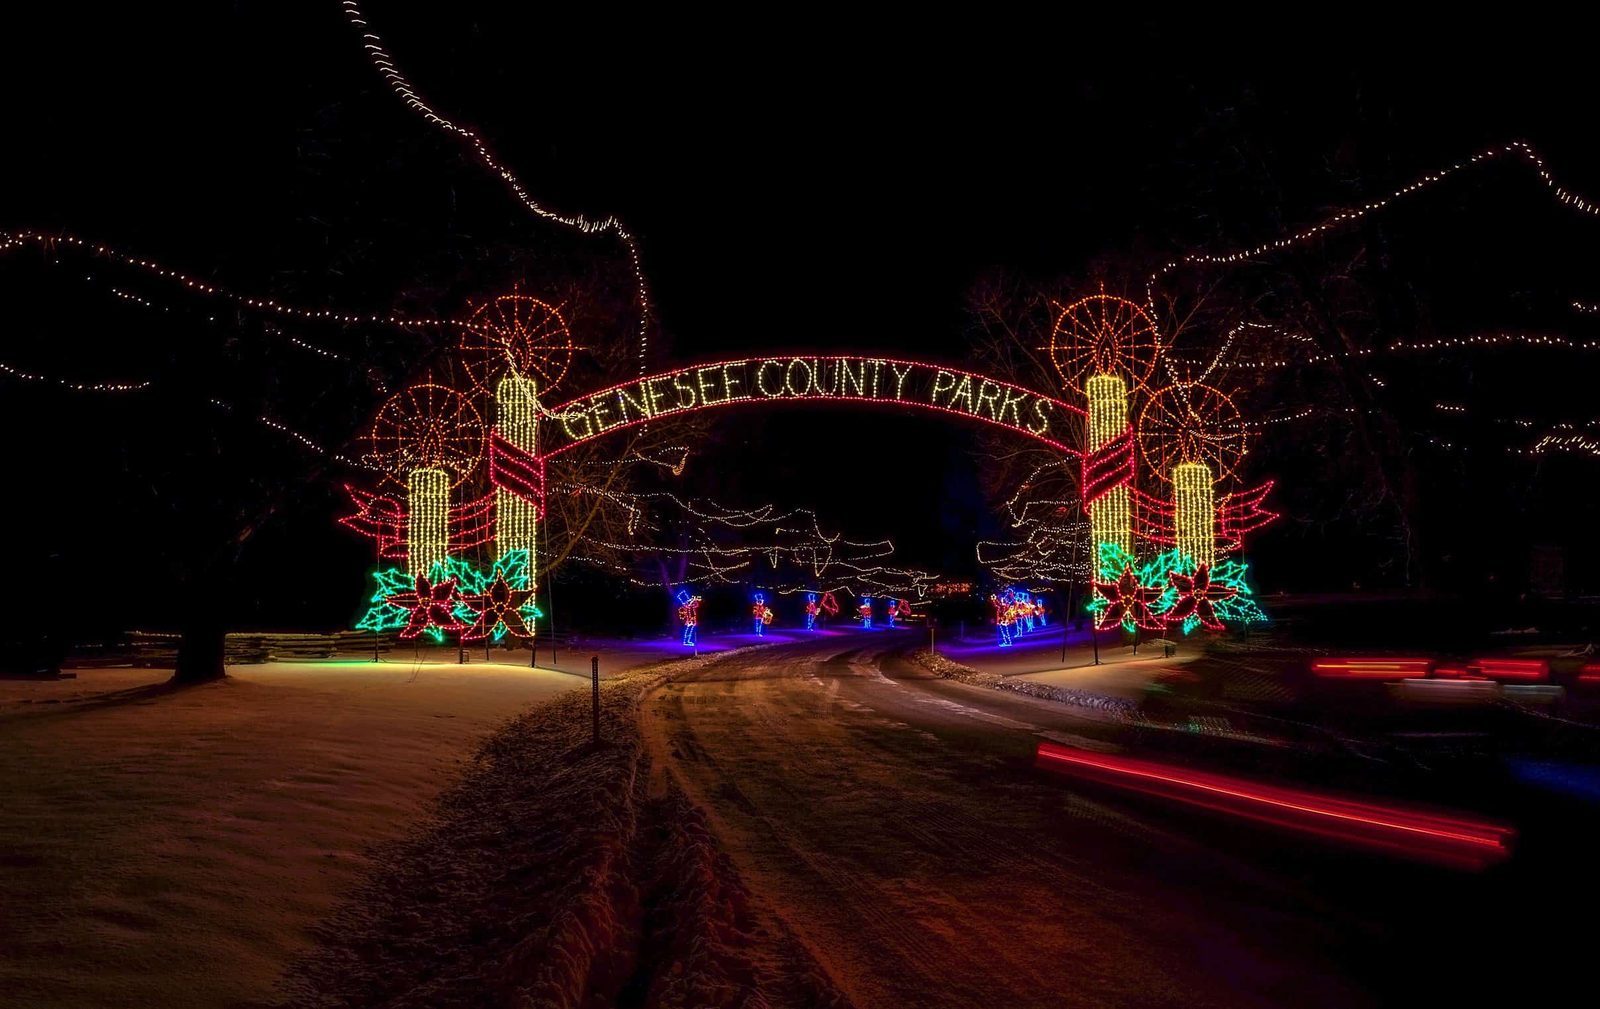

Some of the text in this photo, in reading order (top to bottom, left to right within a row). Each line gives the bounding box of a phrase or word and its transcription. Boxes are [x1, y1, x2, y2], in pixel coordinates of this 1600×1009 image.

[563, 358, 1053, 440] GENESEE COUNTY PARKS
